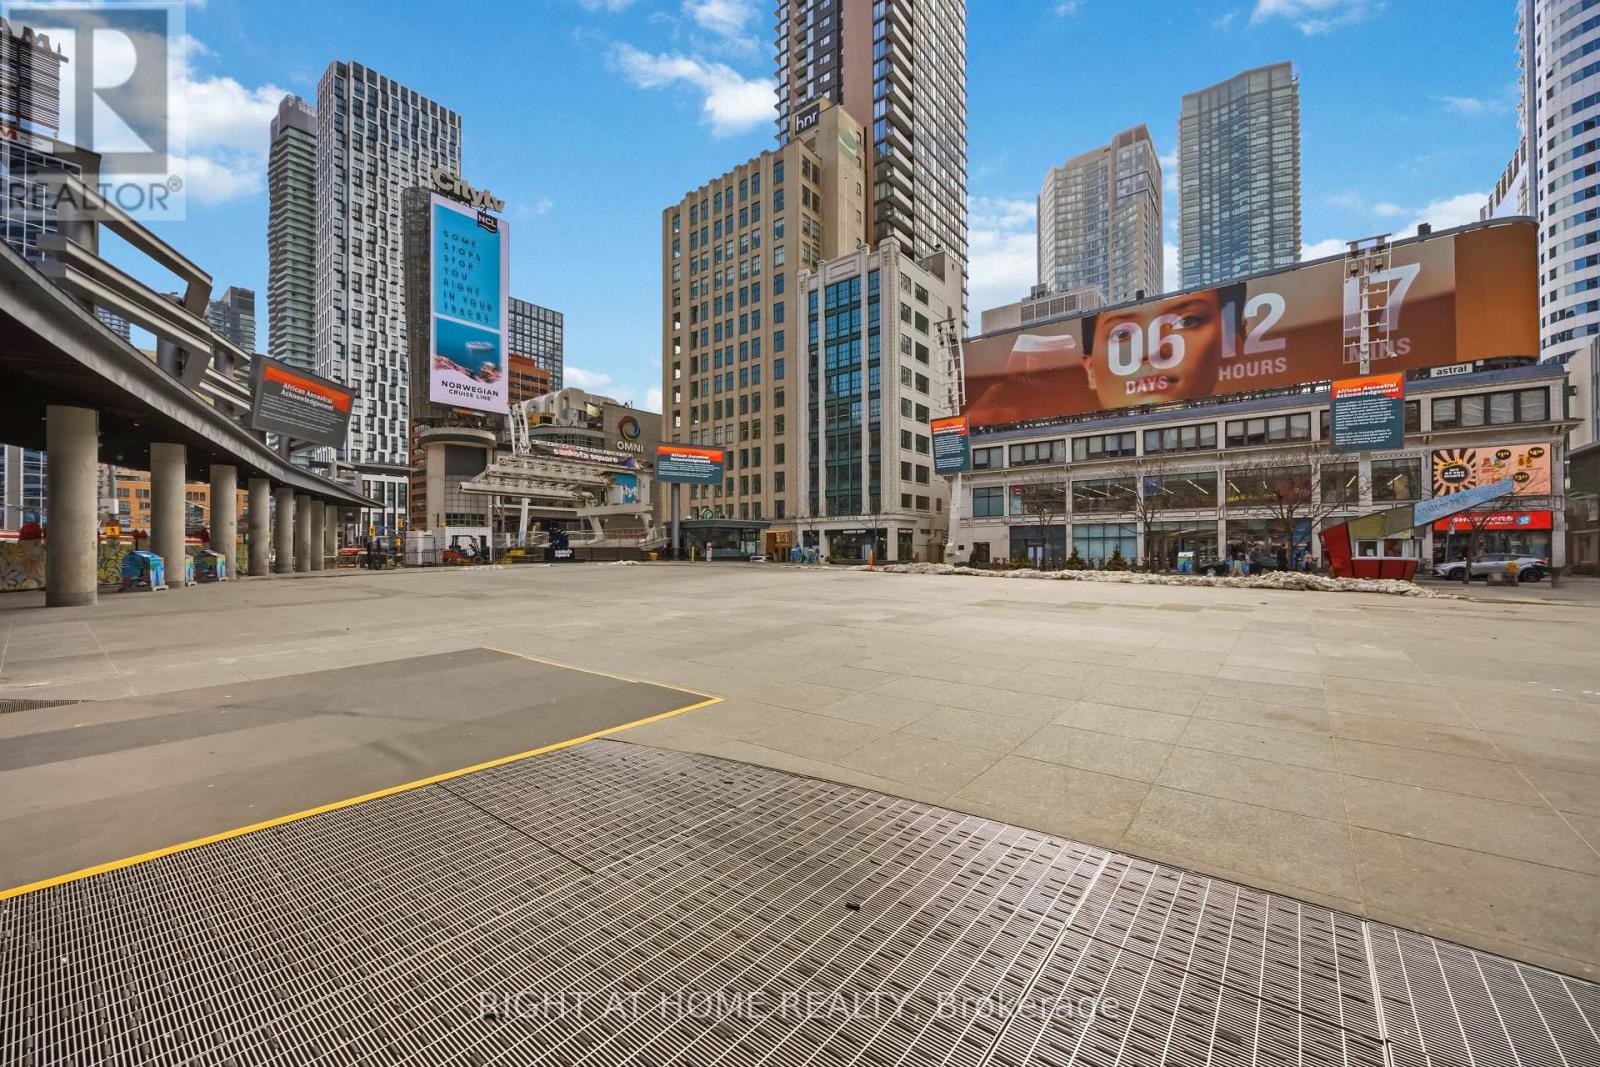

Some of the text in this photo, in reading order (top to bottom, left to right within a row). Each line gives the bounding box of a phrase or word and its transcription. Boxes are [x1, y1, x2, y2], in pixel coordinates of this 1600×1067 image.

[795, 111, 818, 131] hnr
[431, 168, 505, 213] Citytv
[478, 214, 497, 228] NCL
[443, 230, 477, 248] SOME
[443, 242, 481, 261] STOPS
[443, 254, 474, 270] STOP
[443, 266, 468, 281] YOU
[443, 279, 480, 296] RIGHT
[443, 290, 492, 312] IN YOUR
[443, 302, 489, 324] TRACKS
[1108, 263, 1420, 376] 06 12 17
[1125, 337, 1411, 395] DAYS HOURS MINS
[1436, 365, 1468, 376] astral
[283, 383, 333, 404] African Ancestral
[441, 380, 499, 397] NORWEGIAN
[448, 388, 474, 399] CRUISE
[1336, 387, 1399, 399] Acknowledgement
[1363, 381, 1397, 391] Ancestral
[280, 389, 334, 411] Acknowledgement
[616, 441, 644, 453] OMNI
[590, 454, 618, 463] square
